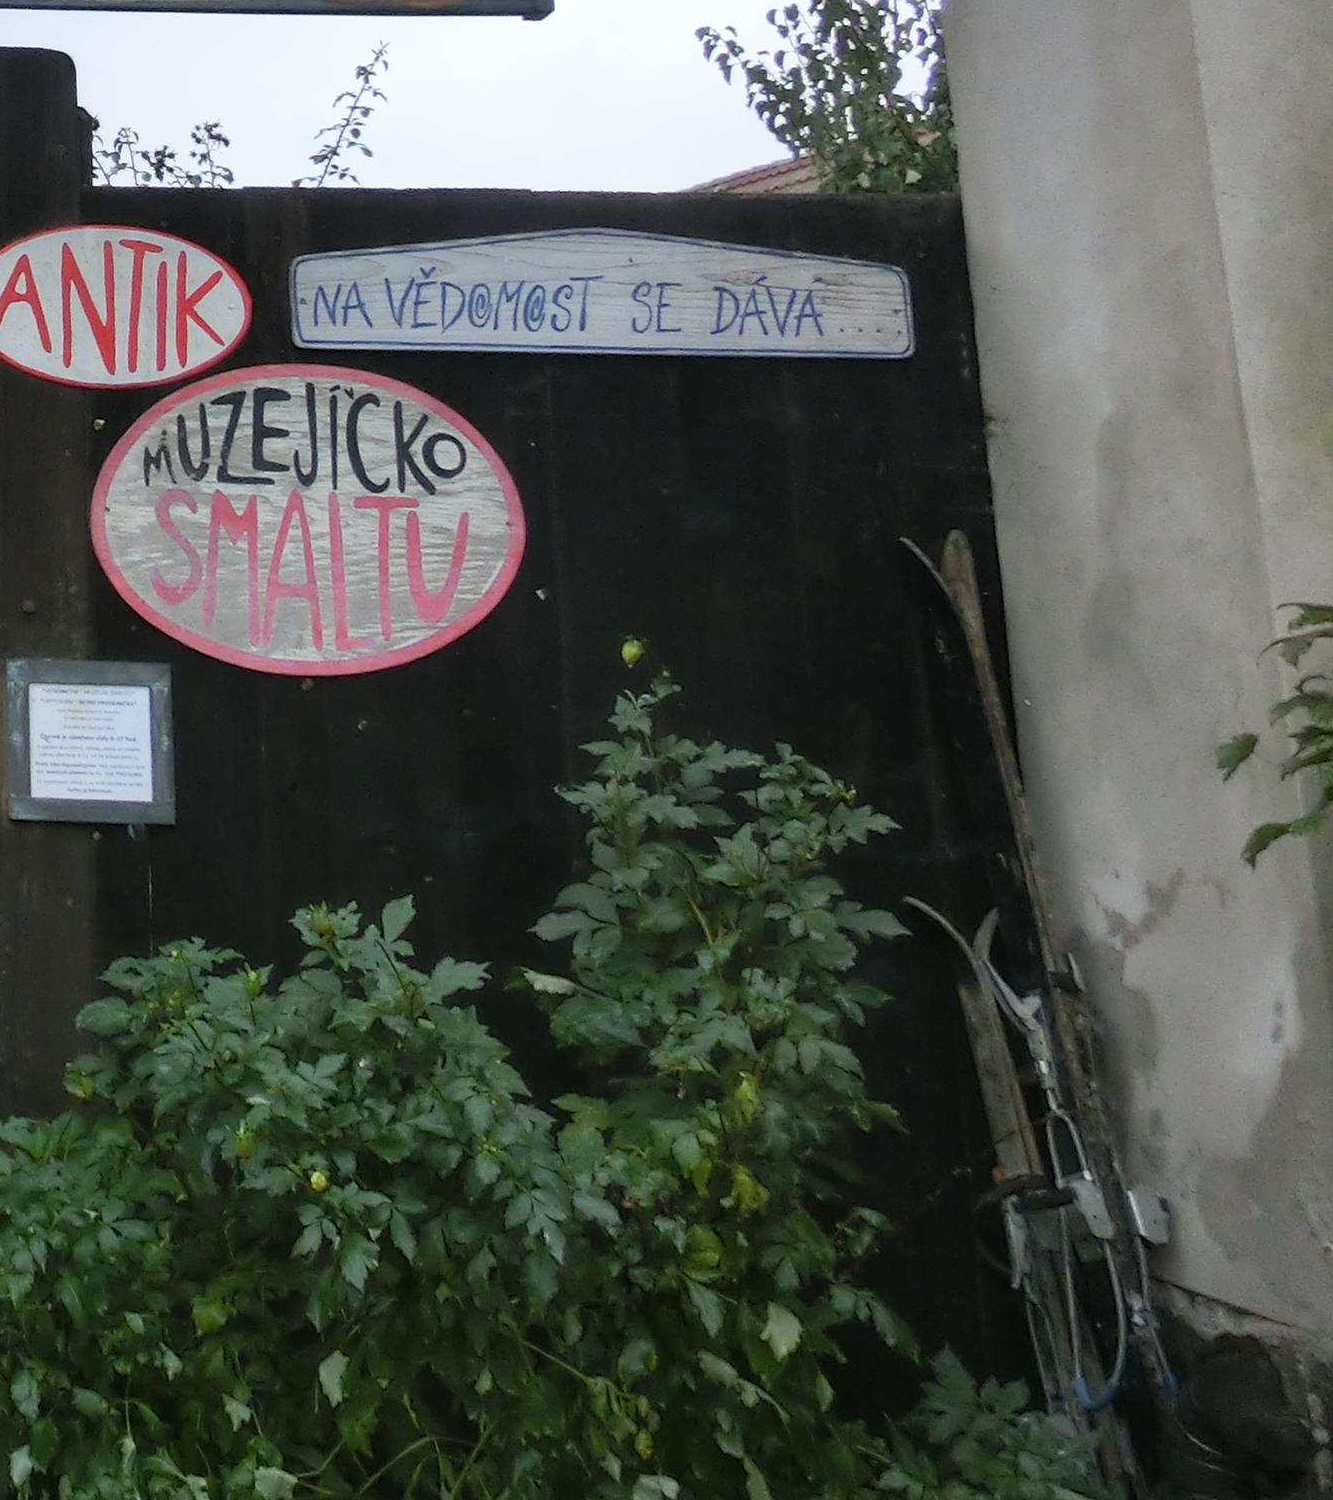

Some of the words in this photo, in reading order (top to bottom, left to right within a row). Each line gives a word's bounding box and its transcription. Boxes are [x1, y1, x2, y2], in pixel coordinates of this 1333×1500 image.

[312, 282, 373, 327] NA
[632, 283, 683, 334] SE
[152, 487, 471, 653] SMALTU
